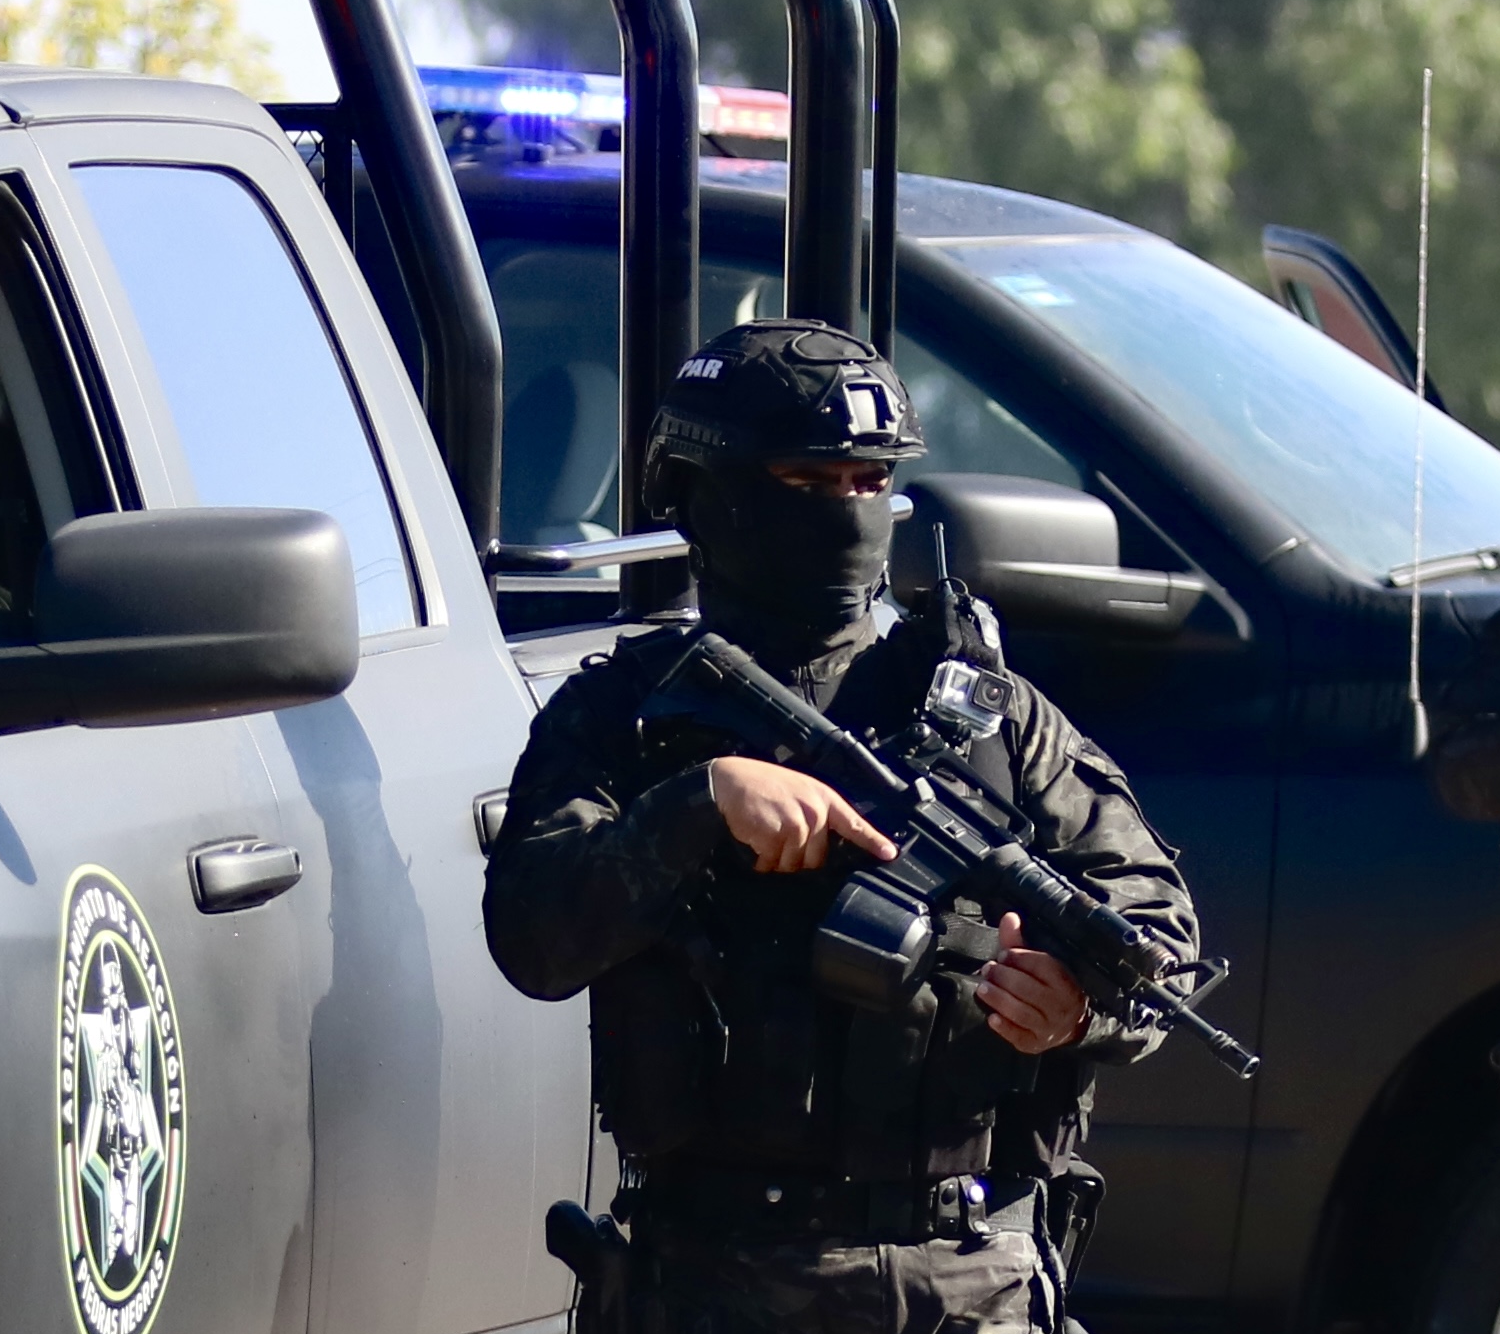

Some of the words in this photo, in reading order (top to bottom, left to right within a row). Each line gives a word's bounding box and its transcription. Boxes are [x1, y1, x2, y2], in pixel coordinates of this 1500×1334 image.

[676, 358, 723, 379] PAR
[63, 888, 106, 1124] AGRUPAMIENTO
[106, 891, 128, 932] DE
